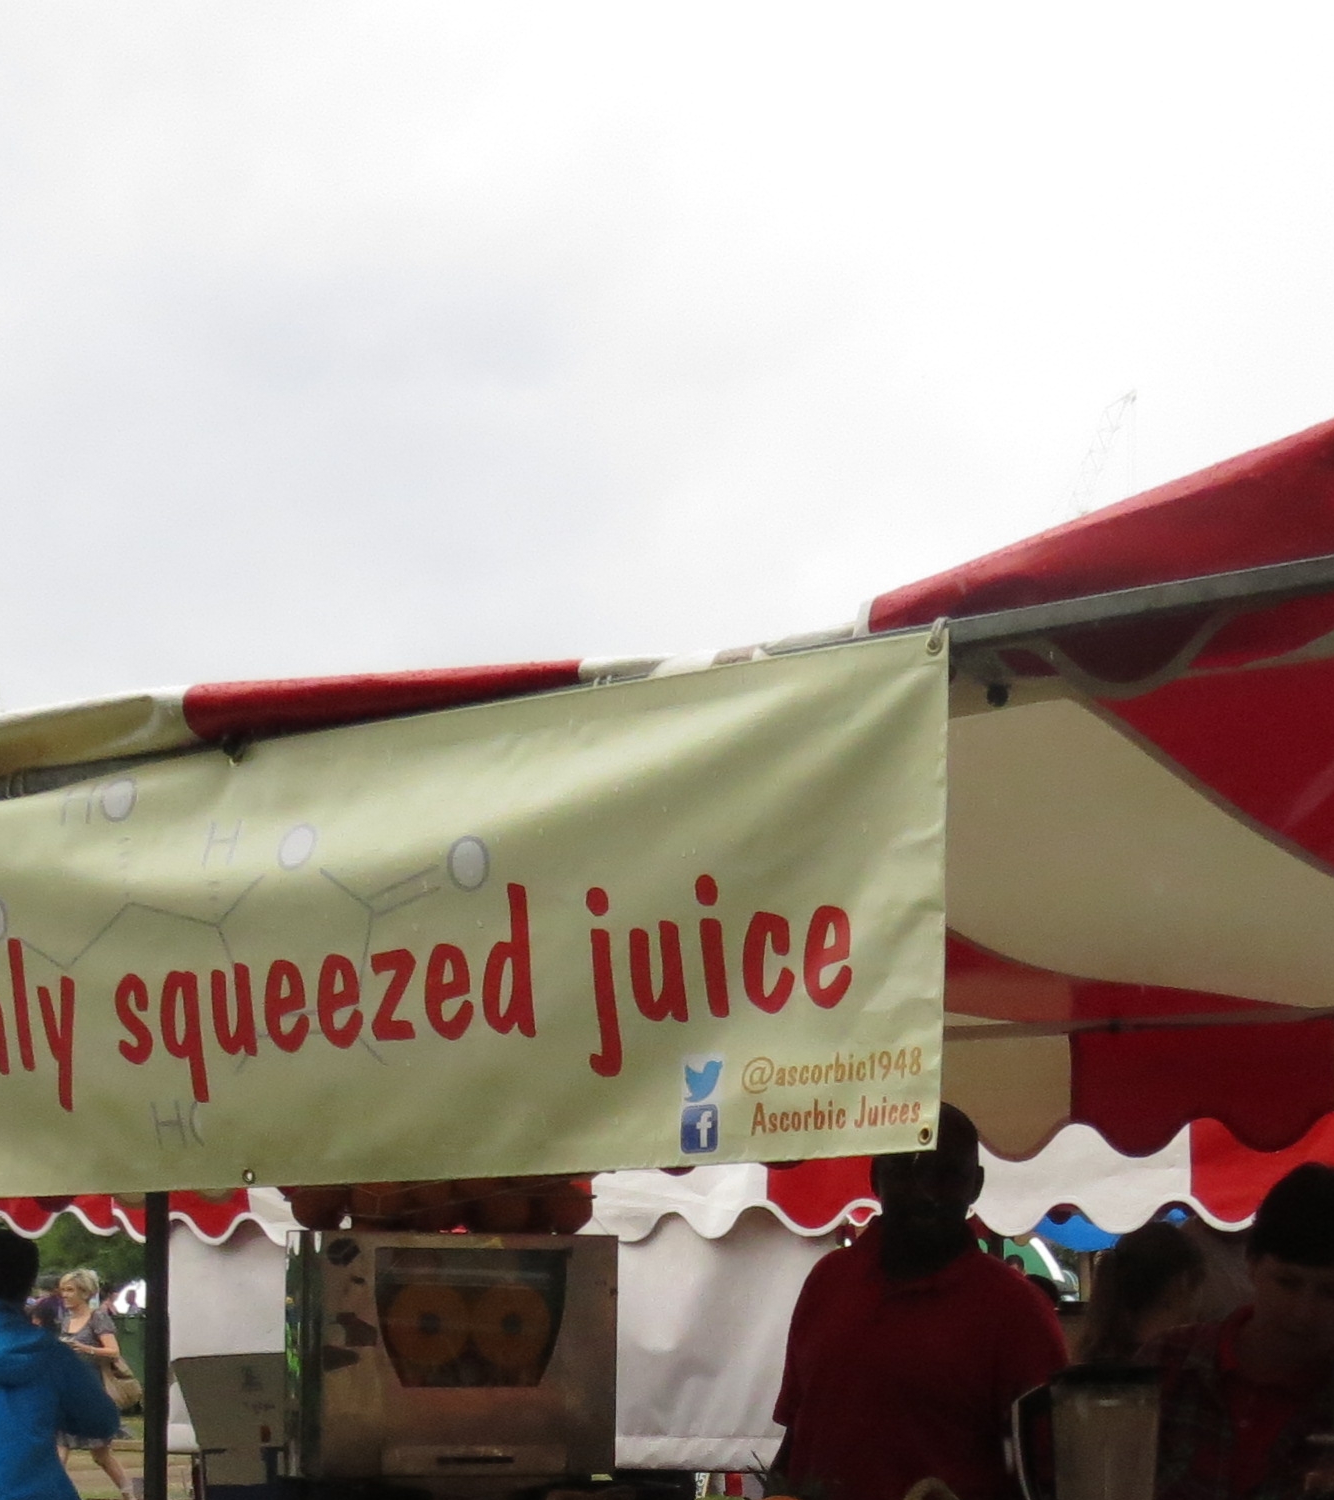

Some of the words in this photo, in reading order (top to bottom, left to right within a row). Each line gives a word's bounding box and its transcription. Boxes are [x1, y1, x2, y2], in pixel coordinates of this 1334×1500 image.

[115, 882, 537, 1103] squeezed
[585, 874, 853, 1078] juice
[741, 1046, 923, 1095] @ascorbic1948
[751, 1098, 847, 1137] Ascorbic
[855, 1095, 921, 1129] Juices
